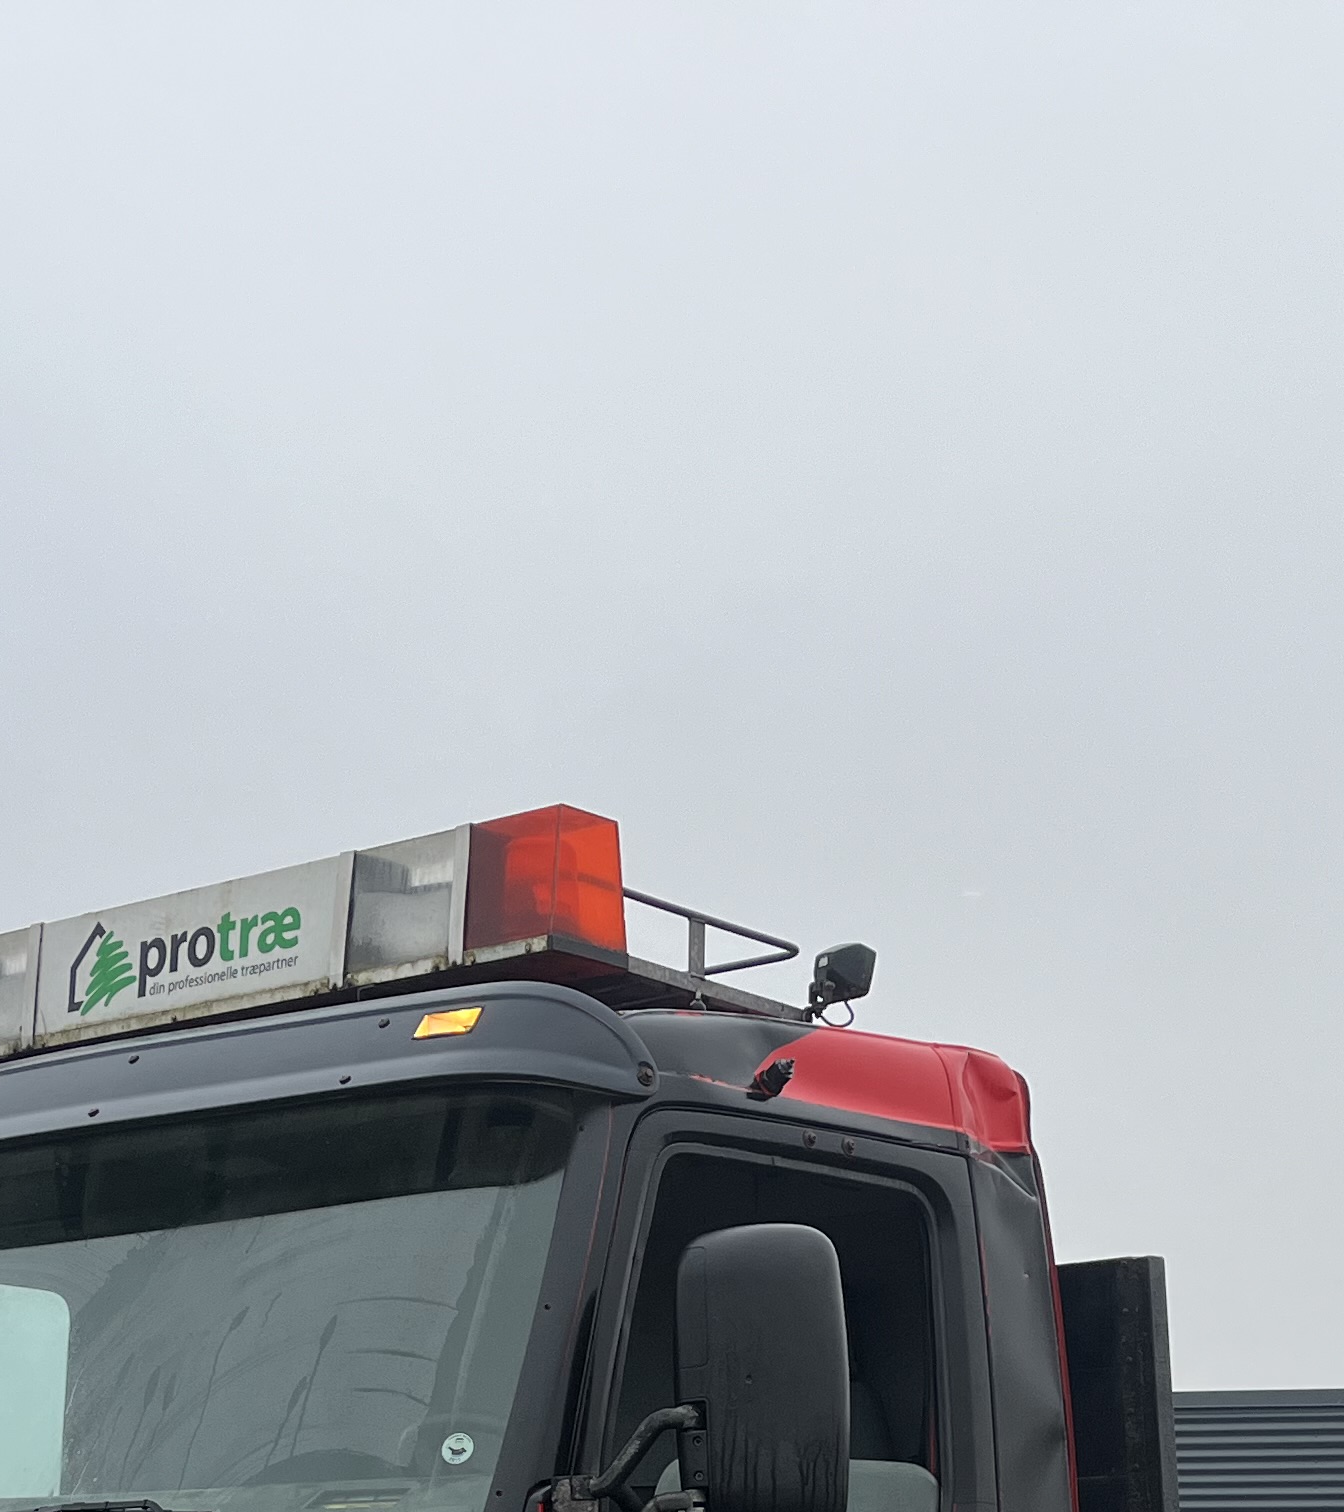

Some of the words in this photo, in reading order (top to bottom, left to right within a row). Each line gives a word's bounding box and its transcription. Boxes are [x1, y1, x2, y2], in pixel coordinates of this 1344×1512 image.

[137, 906, 302, 999] protræ
[149, 981, 165, 997] din
[168, 965, 239, 996] professionelle
[241, 955, 300, 977] træpartner
